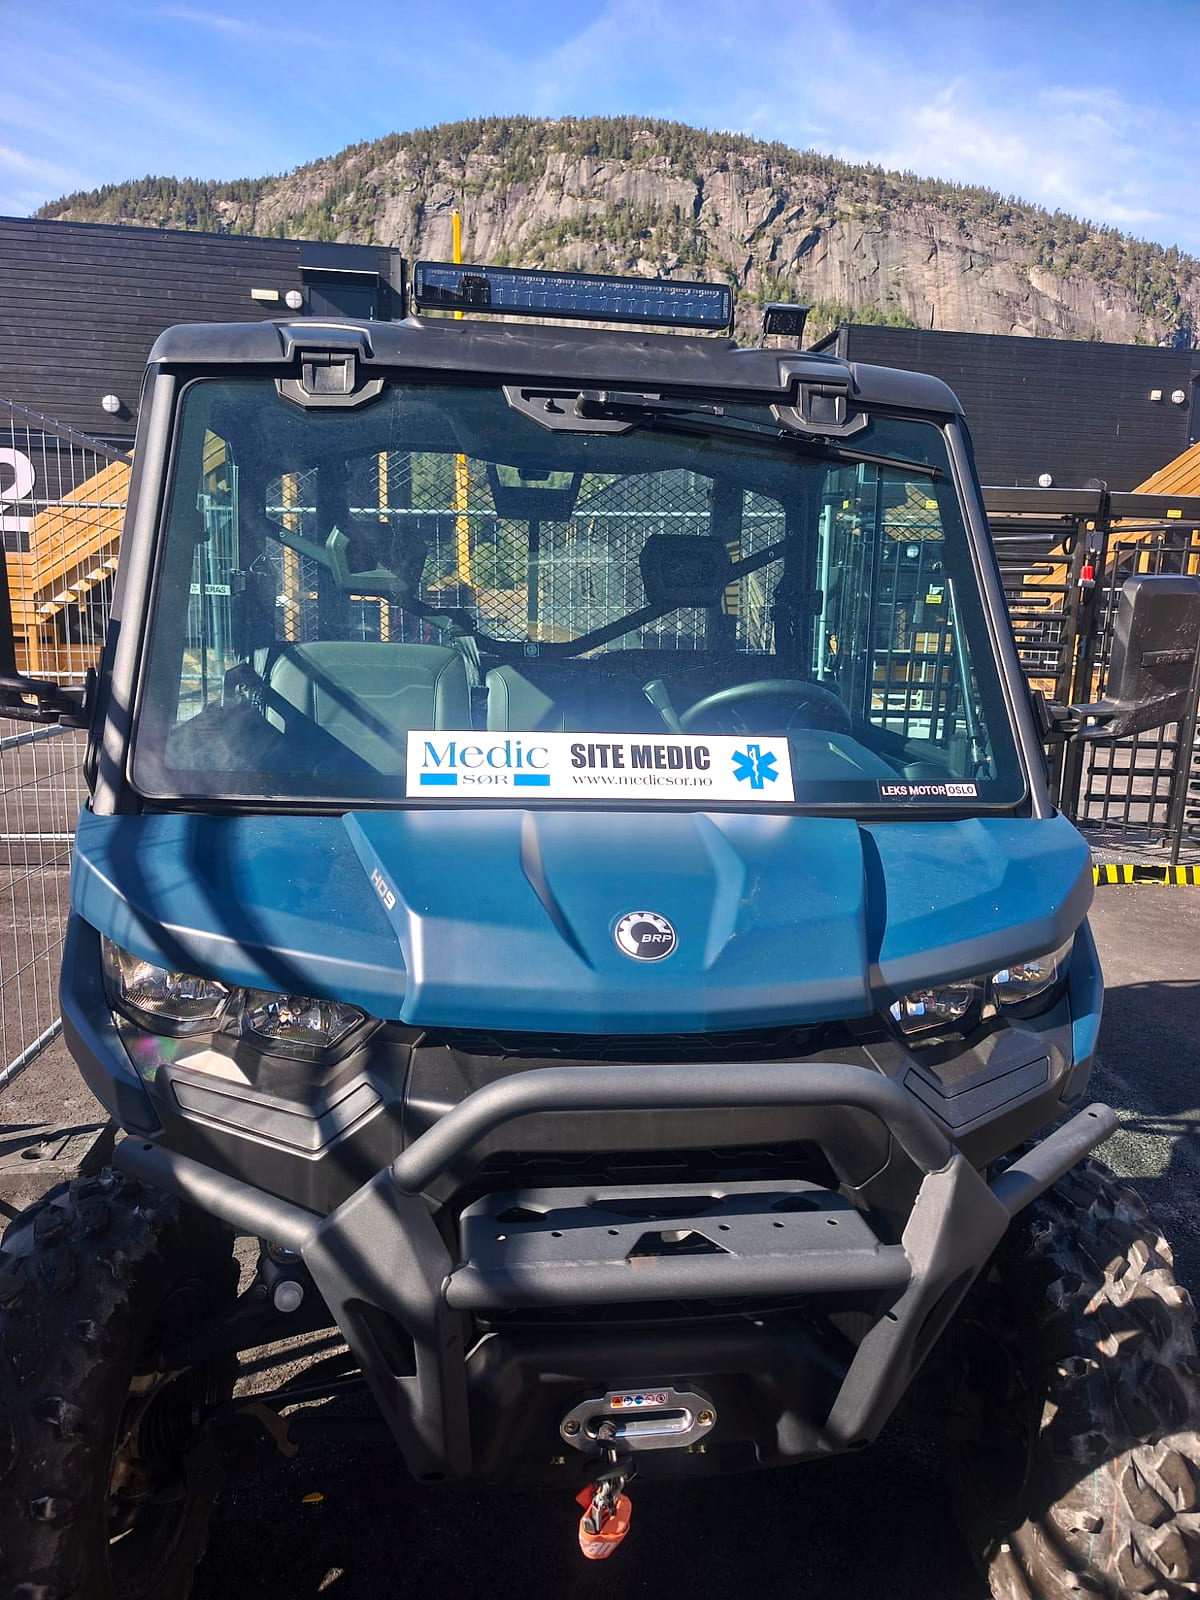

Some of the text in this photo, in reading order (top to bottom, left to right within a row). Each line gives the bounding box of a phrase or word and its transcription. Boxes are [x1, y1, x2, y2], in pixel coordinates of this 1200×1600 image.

[422, 739, 550, 769] Medic
[570, 743, 711, 770] SITE MEDIC
[462, 774, 509, 785] SØR
[572, 774, 713, 786] www.medicsor.no
[881, 785, 974, 796] LEKS MOTOR OSLO
[641, 933, 673, 943] BRP
